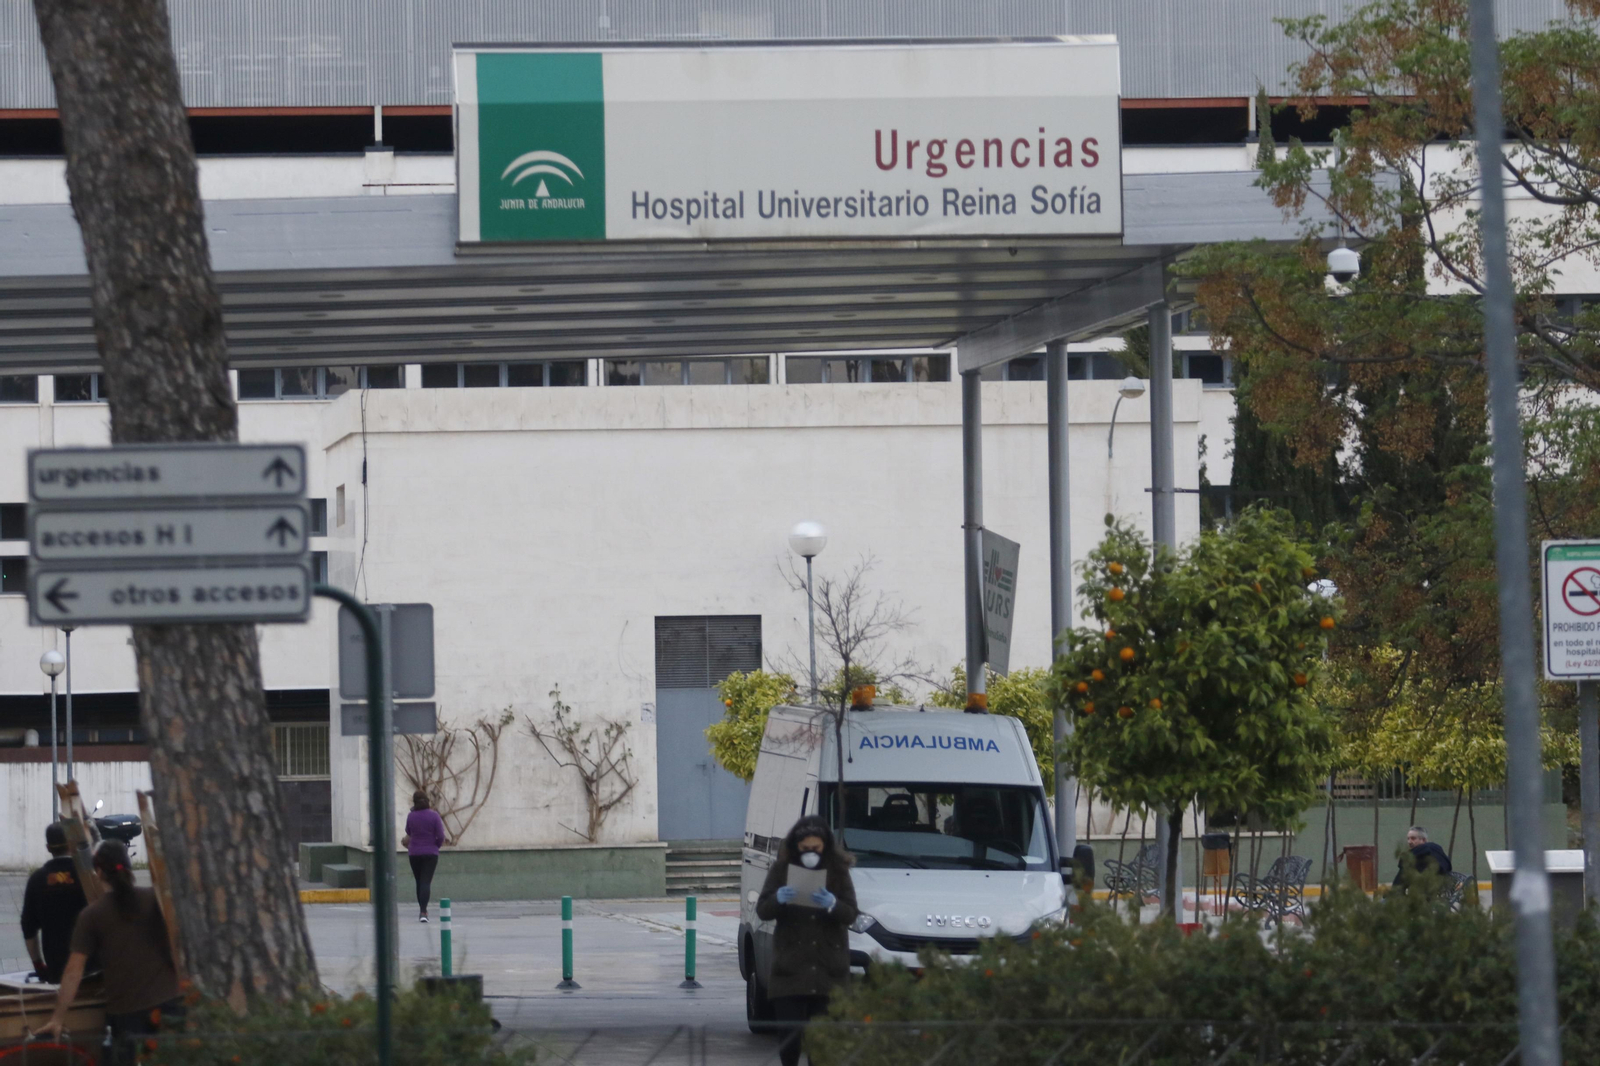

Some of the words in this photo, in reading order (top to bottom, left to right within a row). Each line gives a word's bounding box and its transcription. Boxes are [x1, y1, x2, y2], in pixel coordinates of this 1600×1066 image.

[875, 127, 1100, 178] Urgencias
[499, 199, 525, 210] JUNTA
[527, 198, 539, 210] DE
[632, 190, 745, 225] Hospital
[757, 189, 930, 219] Universitario
[942, 187, 1017, 217] Reina
[1030, 184, 1102, 215] Sofía
[37, 461, 161, 488] urgencias
[41, 528, 146, 548] accesos
[154, 524, 176, 545] H
[110, 582, 181, 605] otros
[191, 583, 299, 603] accesos
[1552, 621, 1596, 632] PROHIBIDO
[1565, 638, 1584, 647] todo
[1586, 638, 1594, 647] el
[926, 914, 992, 929] IVECO
